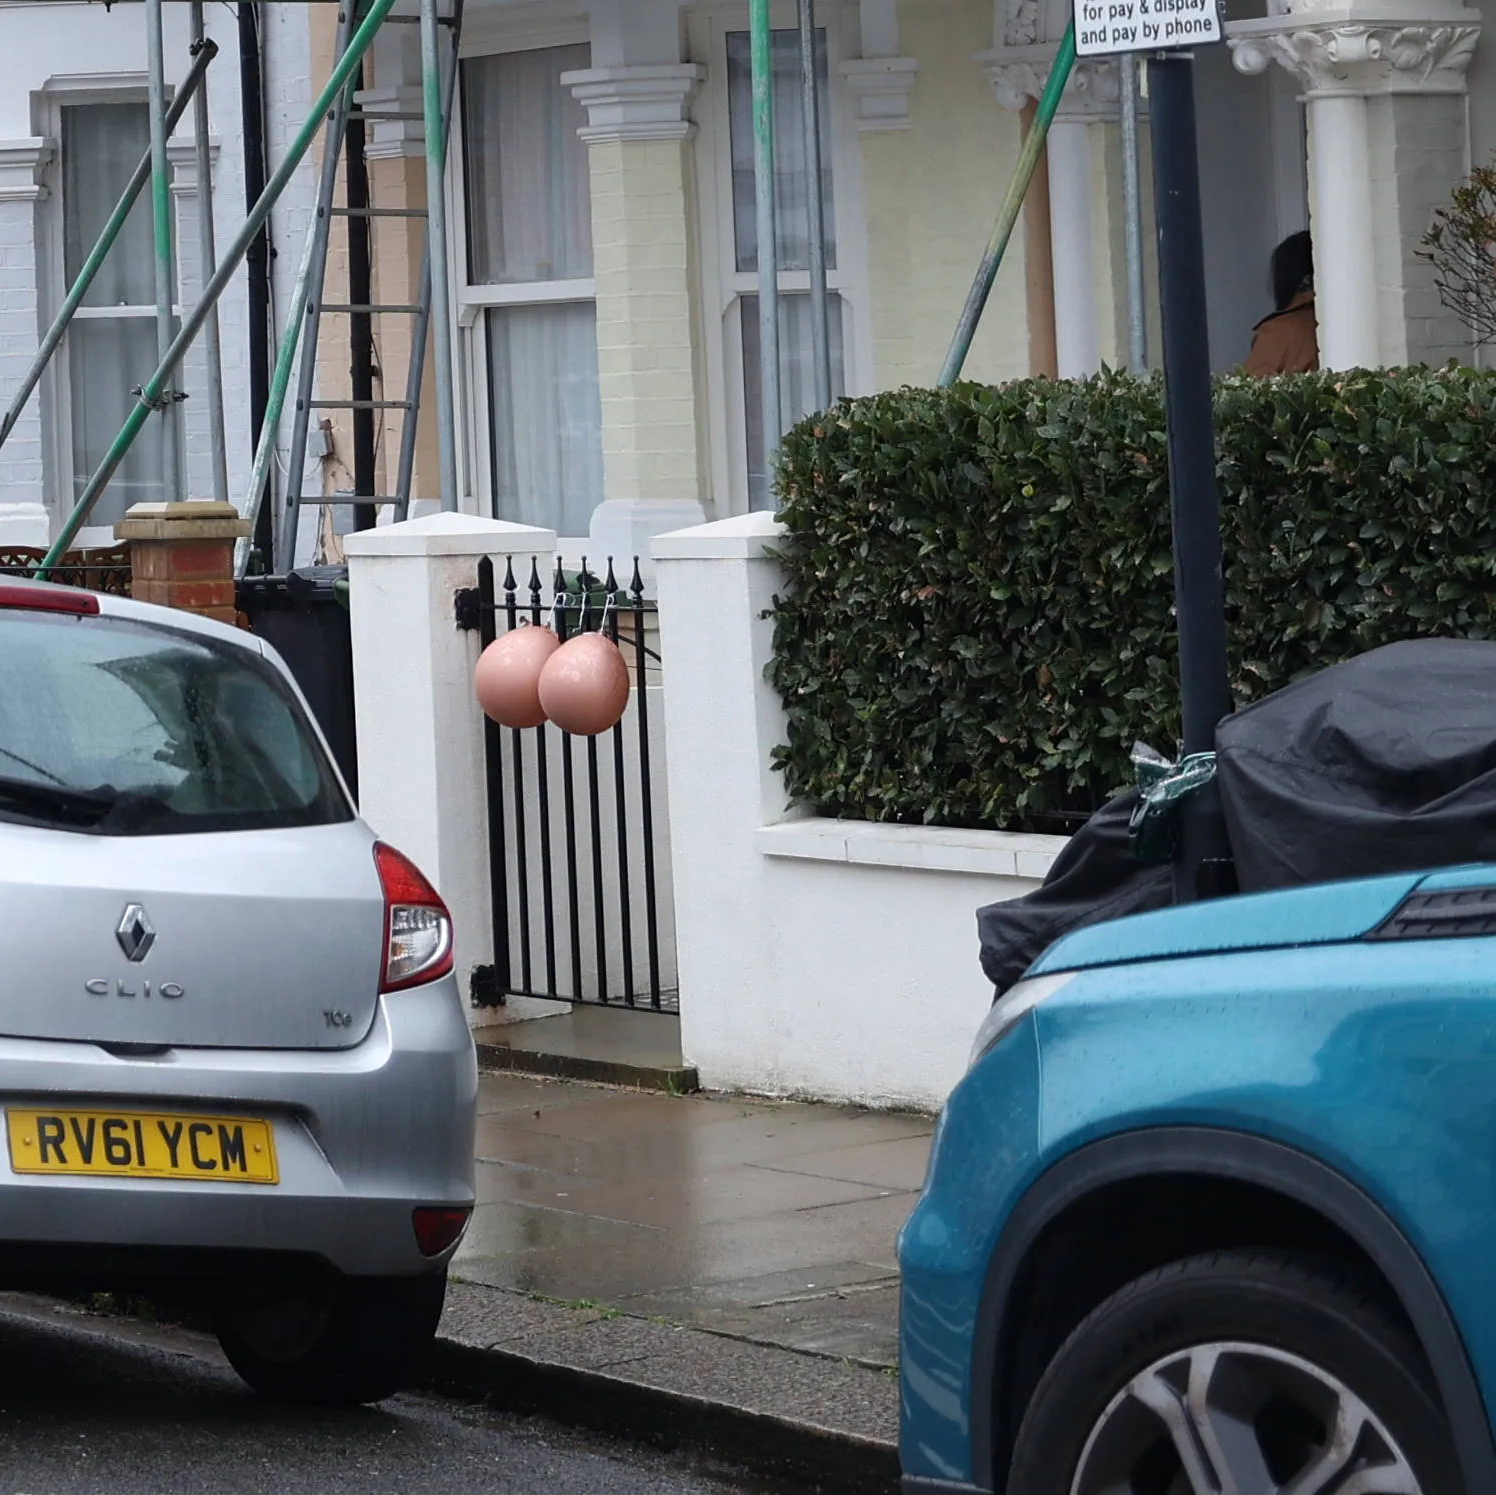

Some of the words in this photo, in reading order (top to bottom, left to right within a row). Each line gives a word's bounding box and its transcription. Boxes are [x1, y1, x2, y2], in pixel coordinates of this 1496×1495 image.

[1082, 2, 1103, 22] for
[1108, 1, 1134, 21] pay
[1081, 25, 1107, 45] and
[1111, 23, 1138, 43] pay
[1143, 19, 1160, 39] by
[1165, 15, 1213, 36] phone
[84, 978, 185, 999] CLIO
[36, 1116, 146, 1167] RV61
[157, 1120, 248, 1172] YCM
